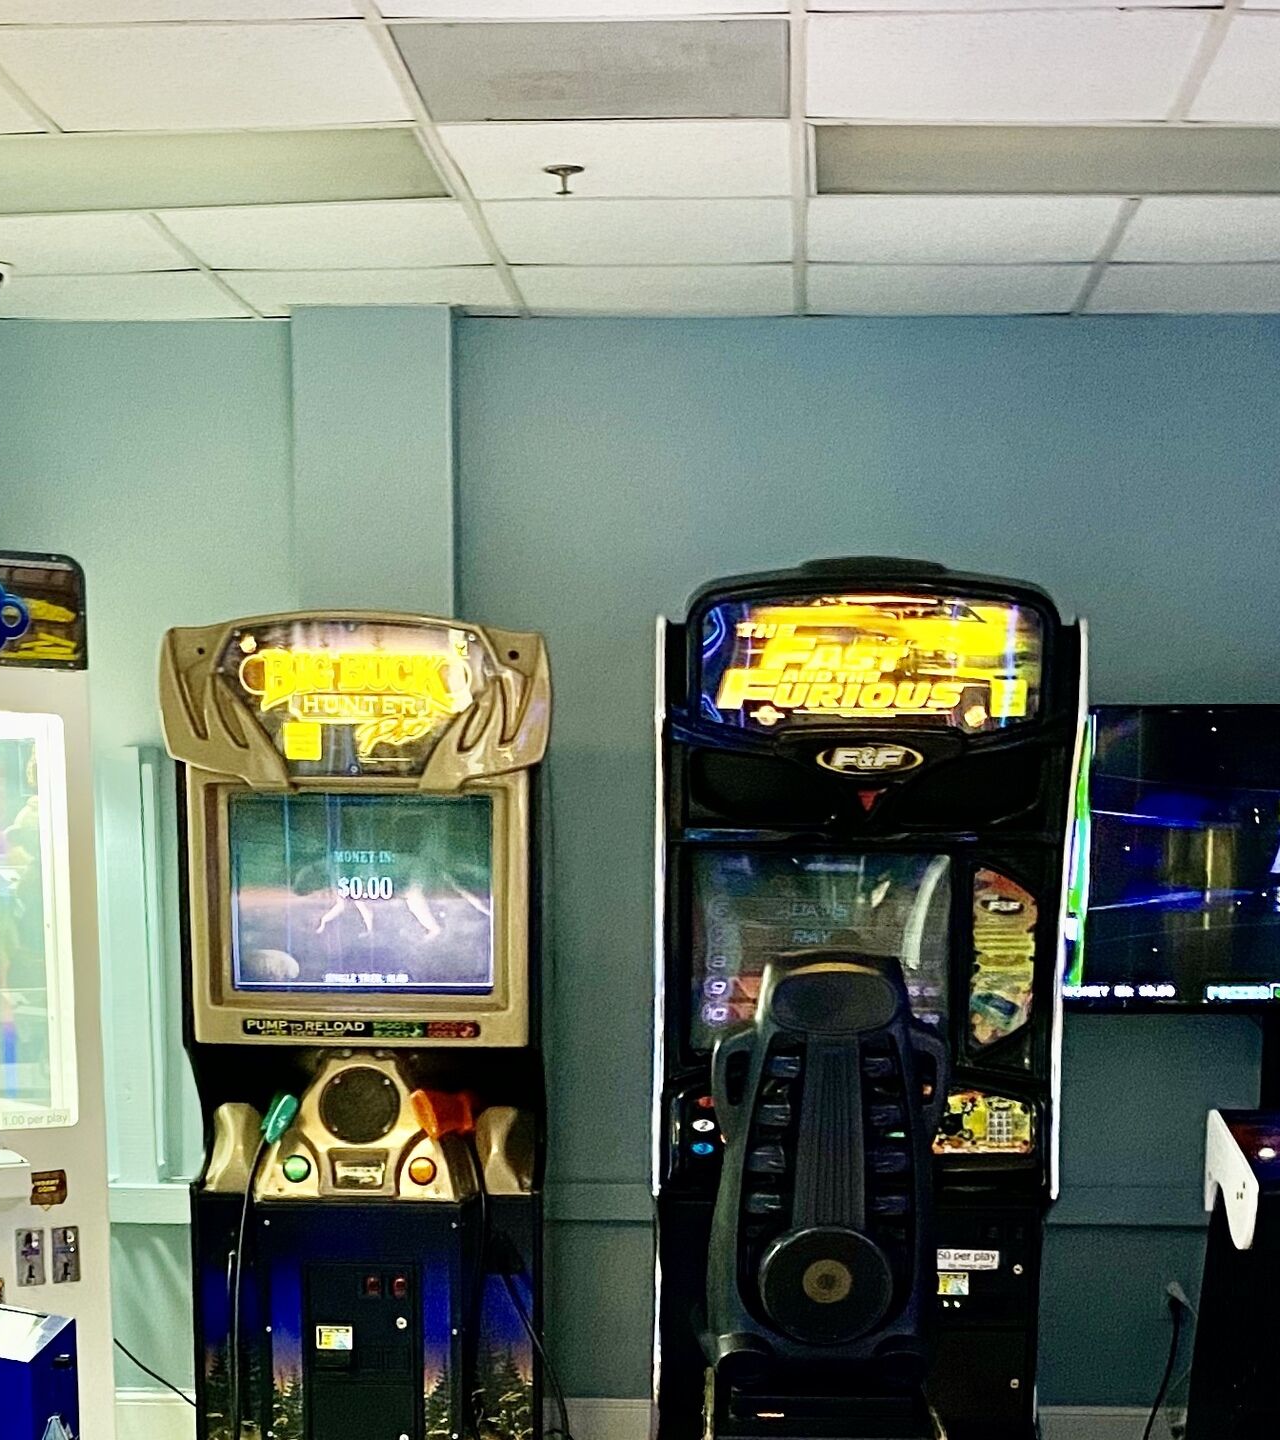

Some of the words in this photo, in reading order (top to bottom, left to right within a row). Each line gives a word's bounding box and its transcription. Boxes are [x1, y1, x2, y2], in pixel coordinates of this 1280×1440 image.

[736, 623, 798, 638] THE
[758, 637, 910, 673] FAST
[261, 651, 335, 704] BIG
[338, 651, 453, 708] BUCK
[717, 668, 966, 709] FURIOUS
[302, 695, 418, 715] HUNTER
[829, 747, 907, 770] F&F
[337, 876, 394, 900] $0.00
[246, 1020, 289, 1031] PUMP
[305, 1020, 365, 1032] RELOAD
[4, 1114, 25, 1126] 1.00
[27, 1115, 44, 1127] per
[47, 1112, 68, 1125] play
[953, 1252, 971, 1264] per
[974, 1250, 997, 1263] play
